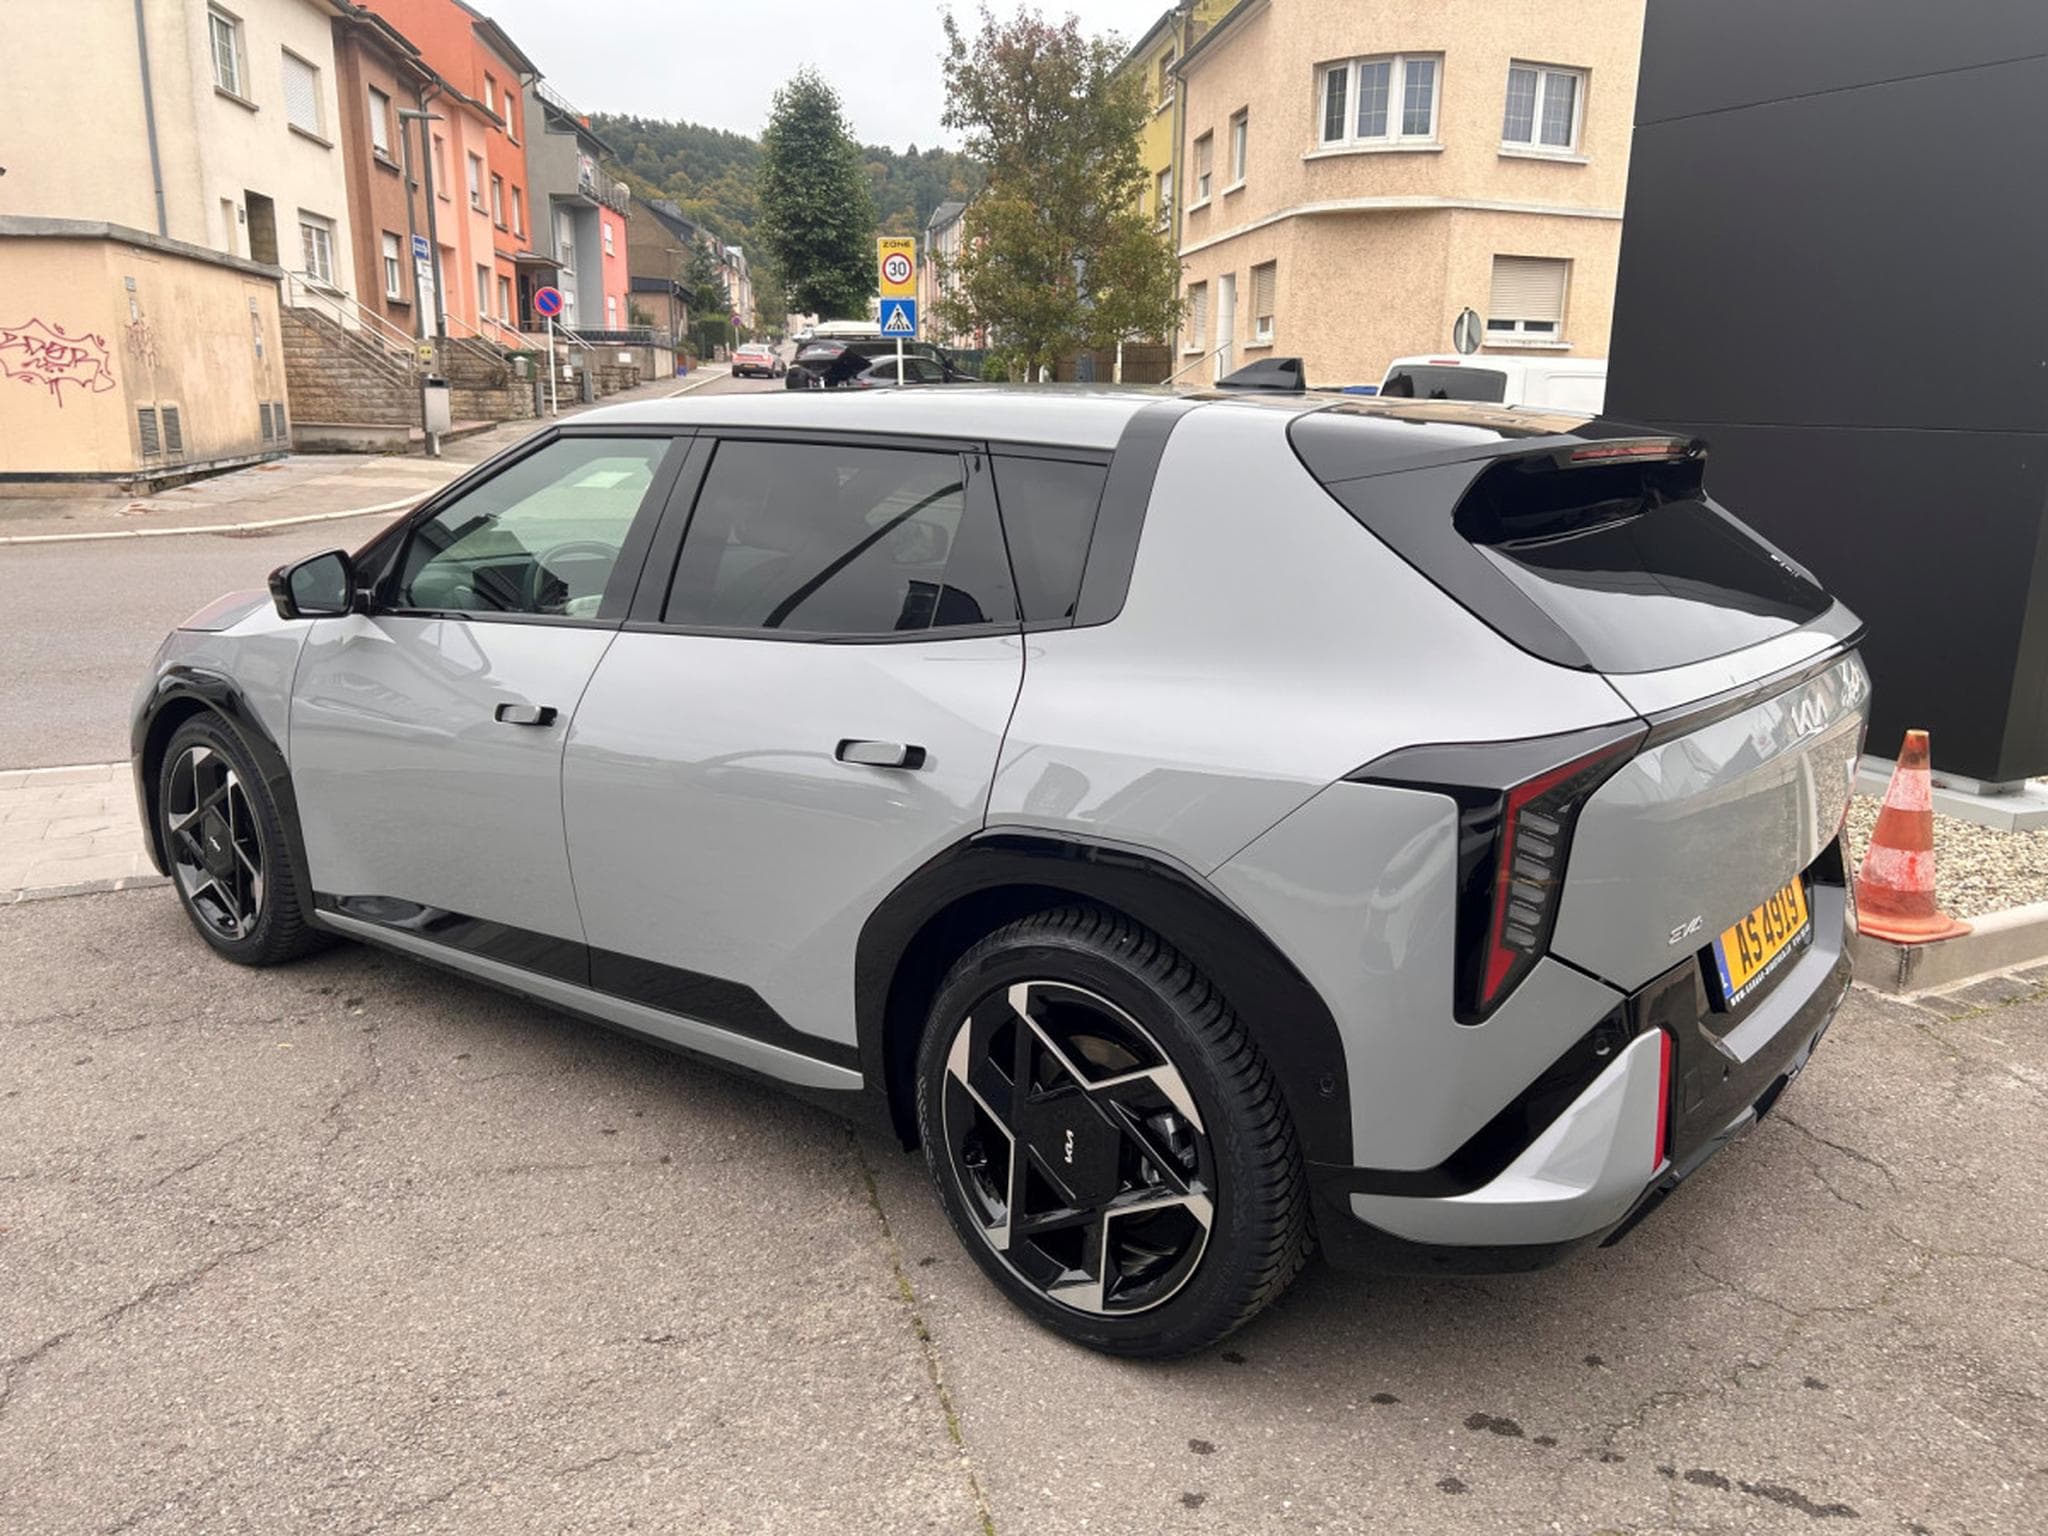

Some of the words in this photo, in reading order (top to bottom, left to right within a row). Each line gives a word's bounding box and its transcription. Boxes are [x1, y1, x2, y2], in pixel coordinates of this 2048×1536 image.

[882, 241, 911, 249] ZONE
[888, 260, 907, 277] 30
[1735, 914, 1764, 976] AS
[1762, 884, 1799, 947] 4919
